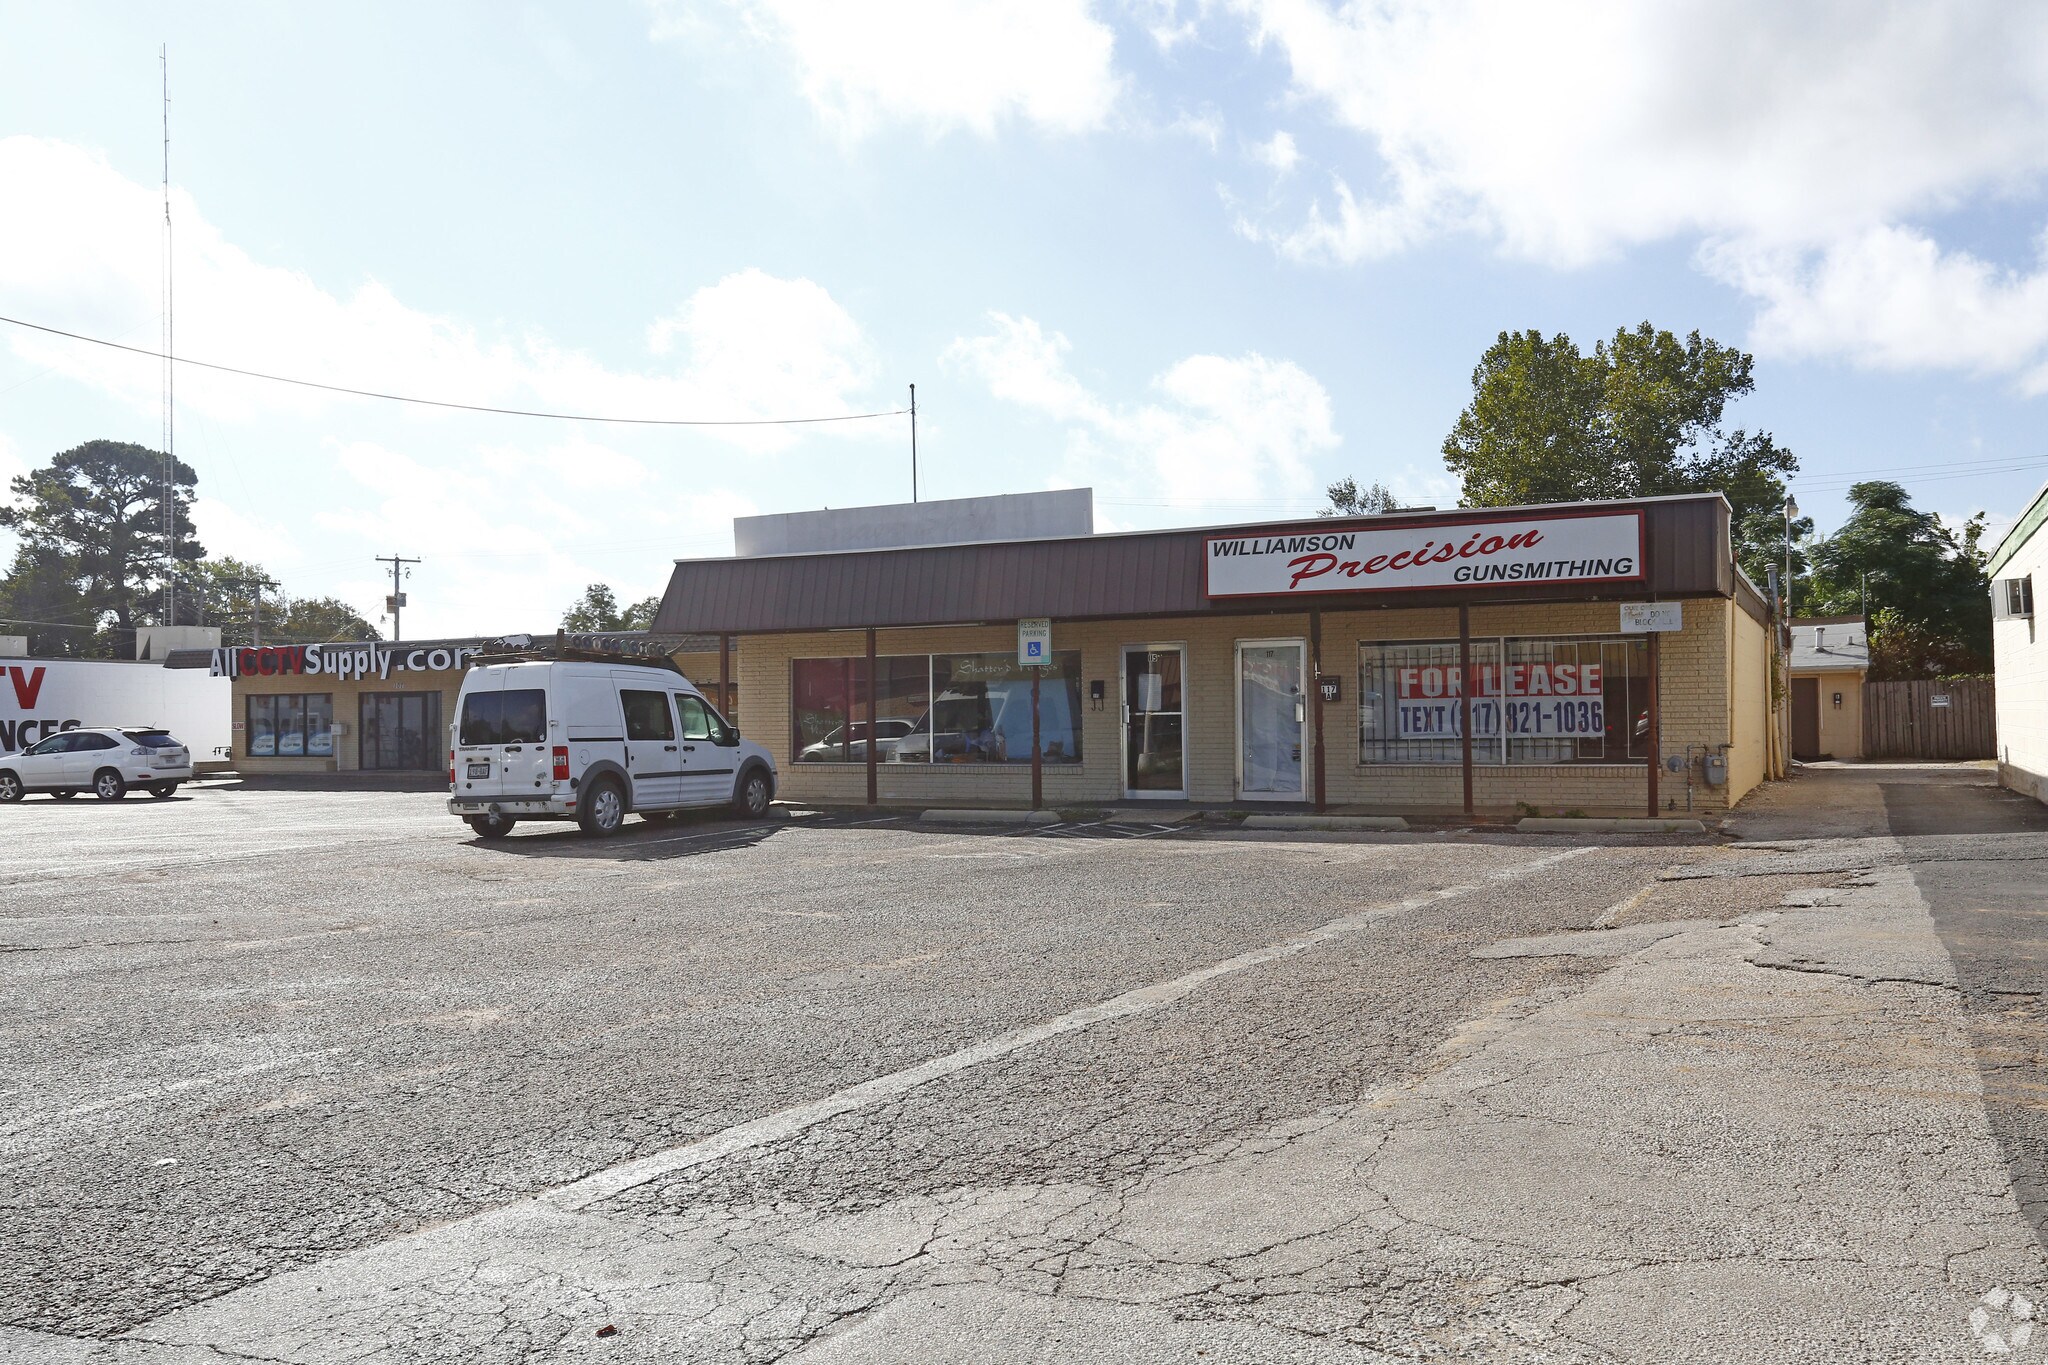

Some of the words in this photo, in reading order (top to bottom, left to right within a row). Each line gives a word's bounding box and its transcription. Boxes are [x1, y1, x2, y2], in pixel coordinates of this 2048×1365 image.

[1213, 534, 1355, 556] WILLIAMSON
[1287, 529, 1544, 589] Precision
[1453, 557, 1633, 582] GUNSMITHING
[1400, 666, 1462, 698] FOR
[1482, 663, 1601, 696] LEASE
[1400, 706, 1445, 733] TEXT
[1507, 700, 1603, 734] 821-1036
